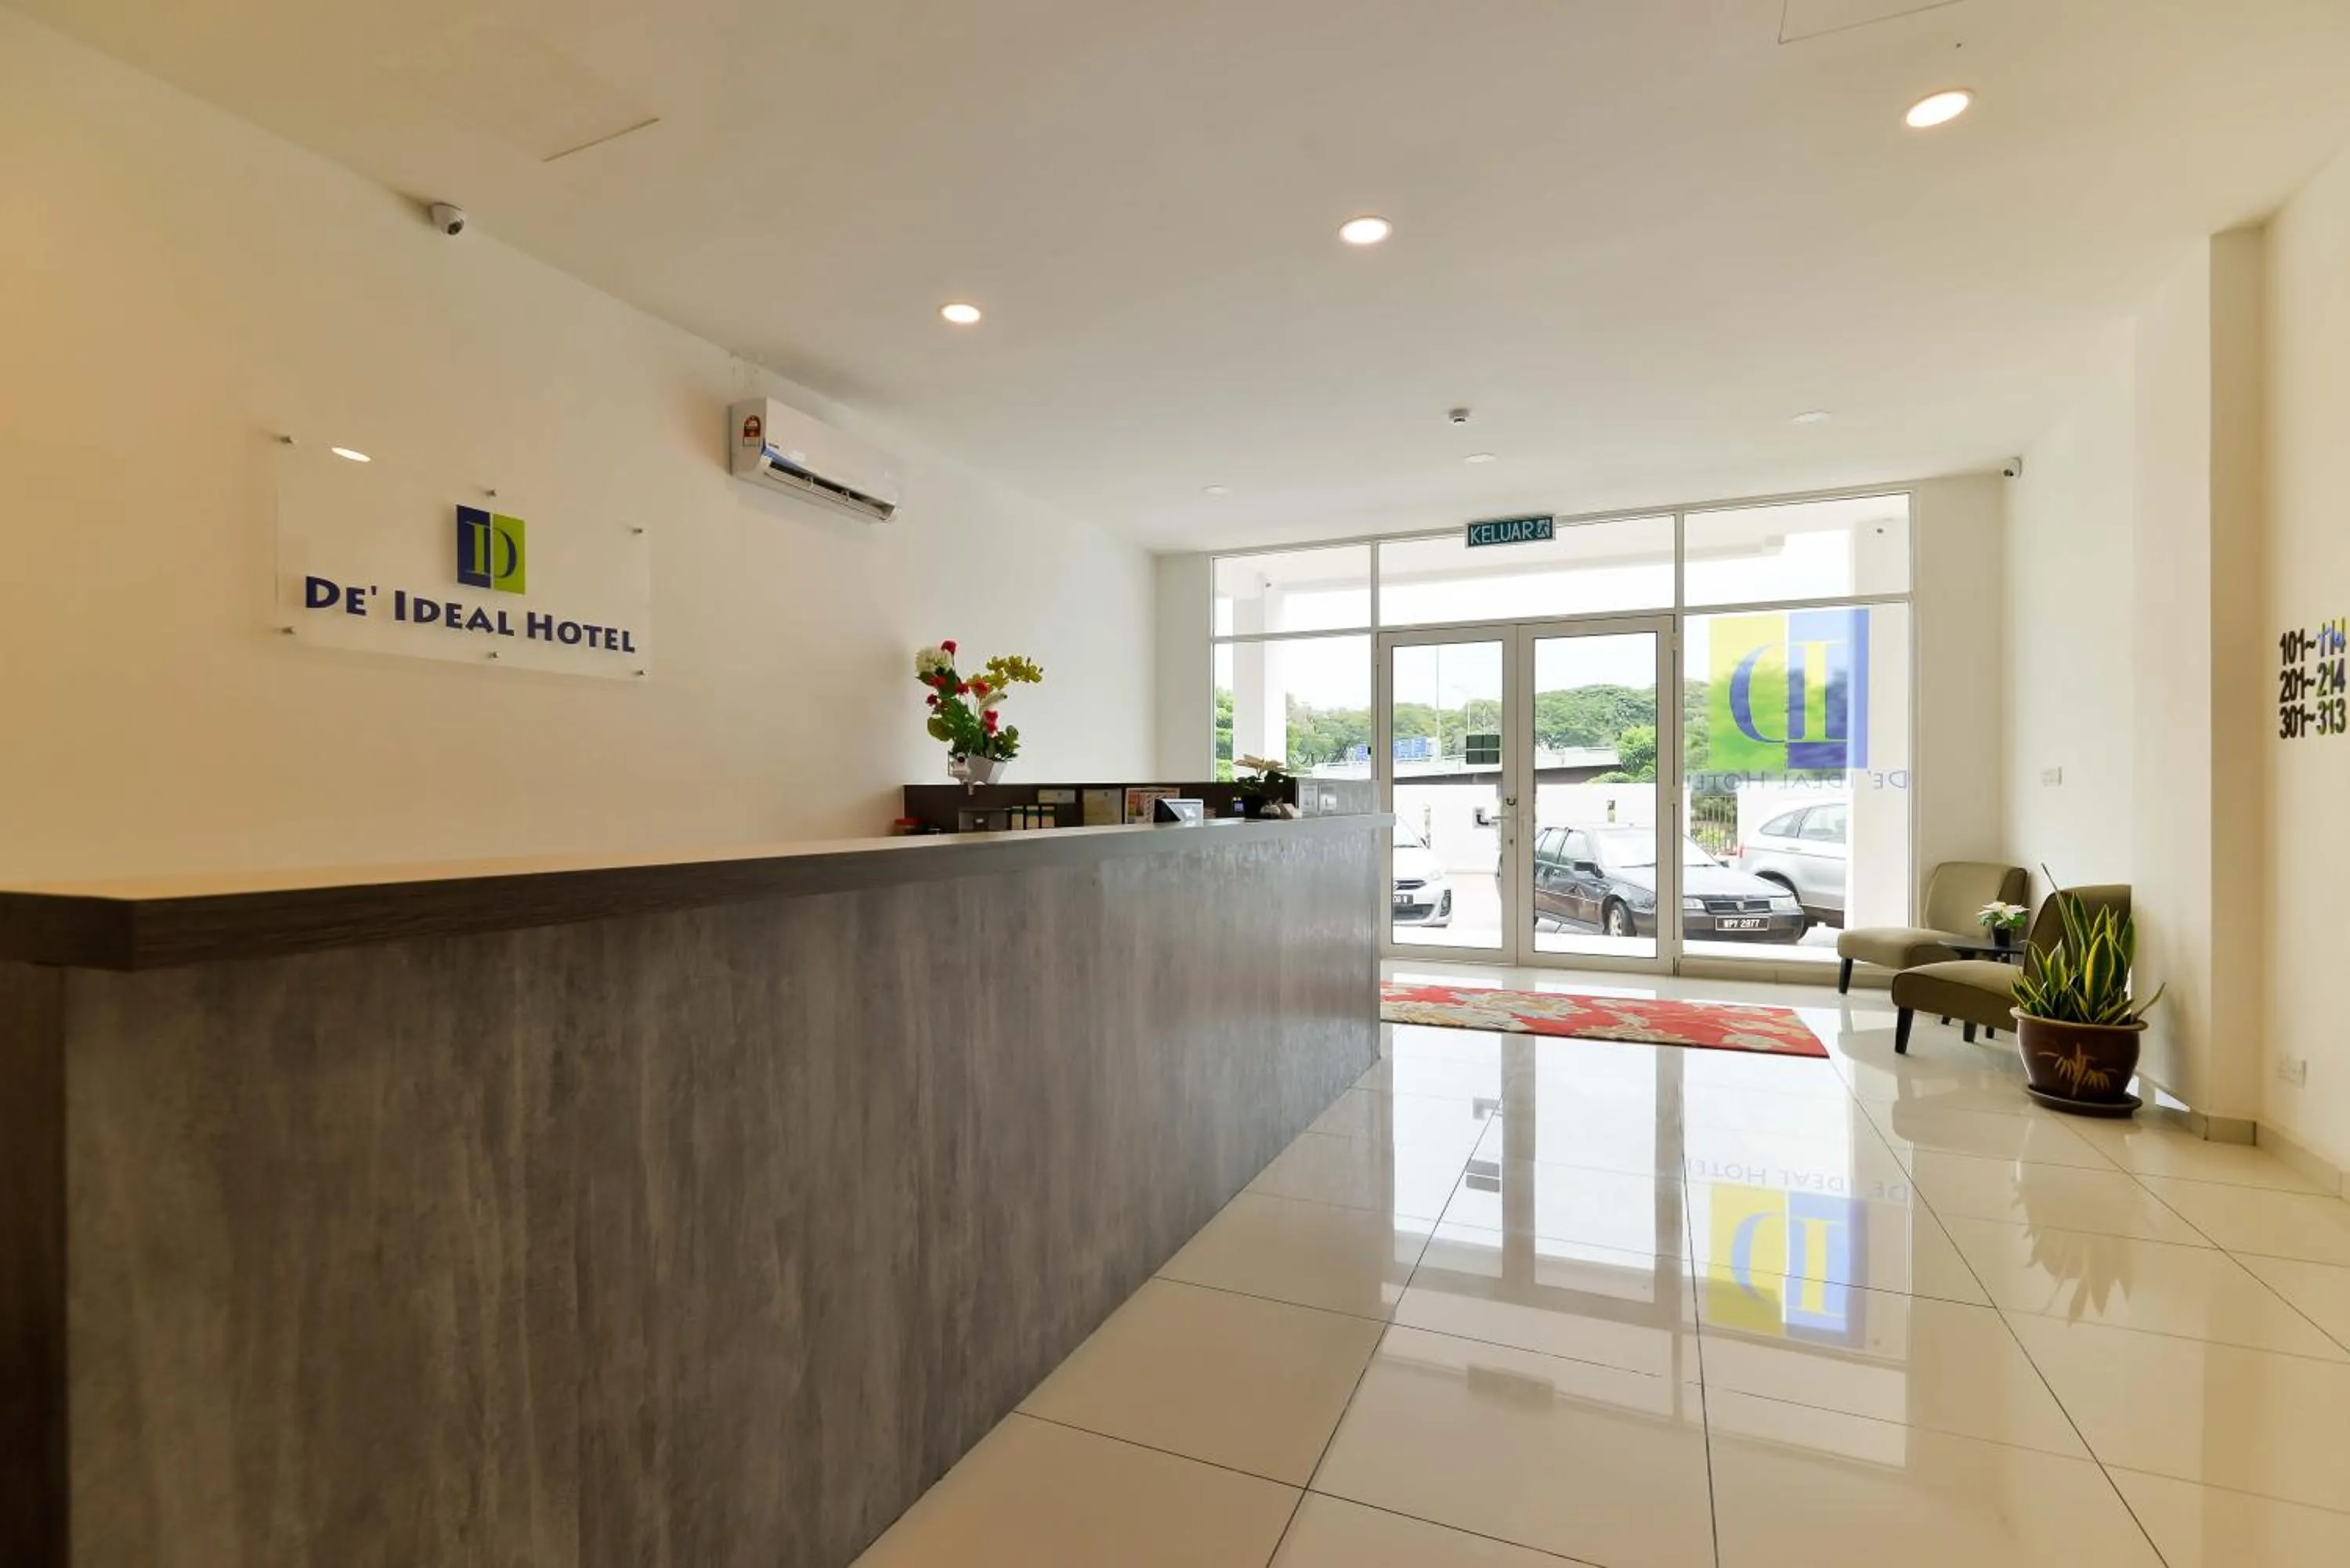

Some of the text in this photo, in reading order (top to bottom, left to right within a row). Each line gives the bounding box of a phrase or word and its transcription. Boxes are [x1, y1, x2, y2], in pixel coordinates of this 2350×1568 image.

[1470, 520, 1535, 544] KELUAR
[305, 575, 635, 653] DE' IDEAL HOTEL
